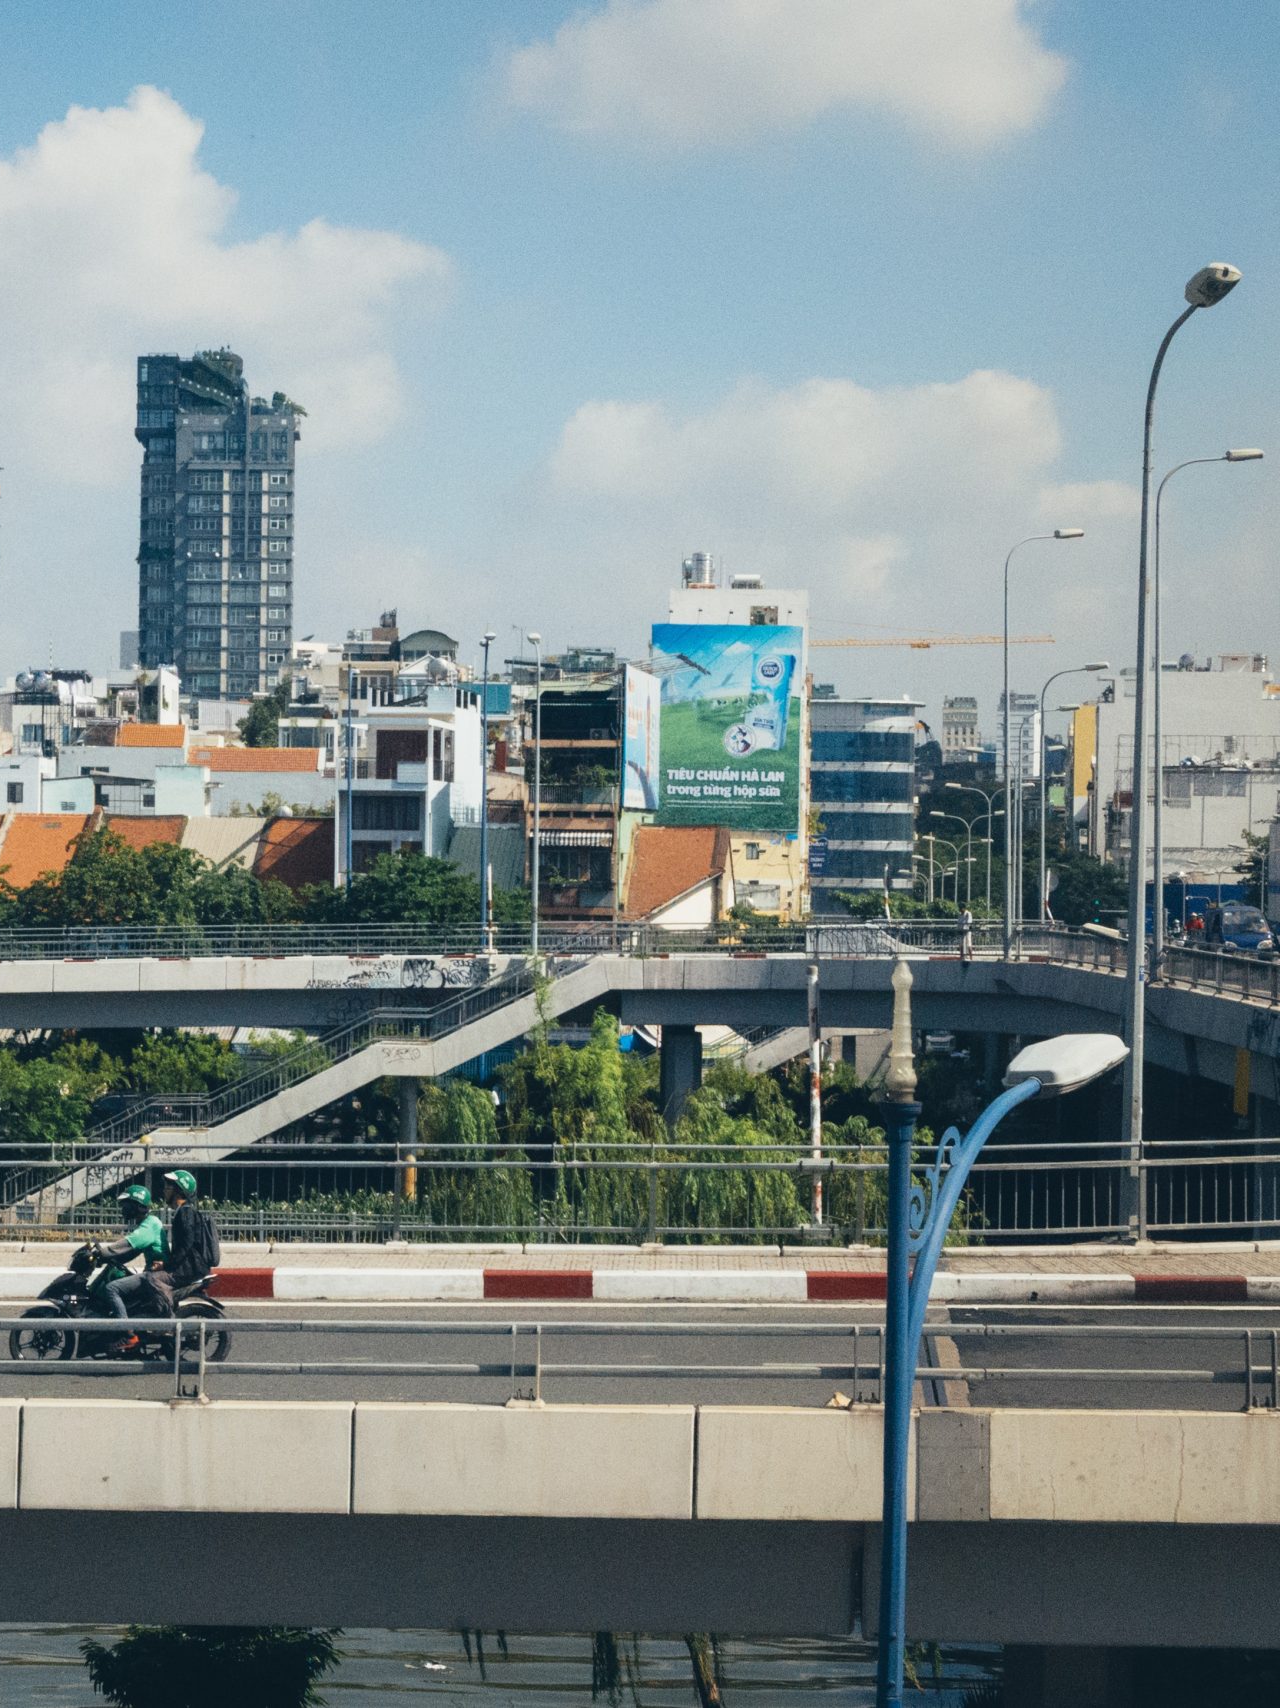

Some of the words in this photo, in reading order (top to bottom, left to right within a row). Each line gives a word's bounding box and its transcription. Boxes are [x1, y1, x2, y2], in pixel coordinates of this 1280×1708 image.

[667, 766, 695, 780] TIÊU
[741, 767, 759, 781] HÀ
[761, 770, 785, 782] LAN
[667, 784, 701, 797] trong
[733, 784, 757, 798] hộp
[758, 785, 781, 797] sữa
